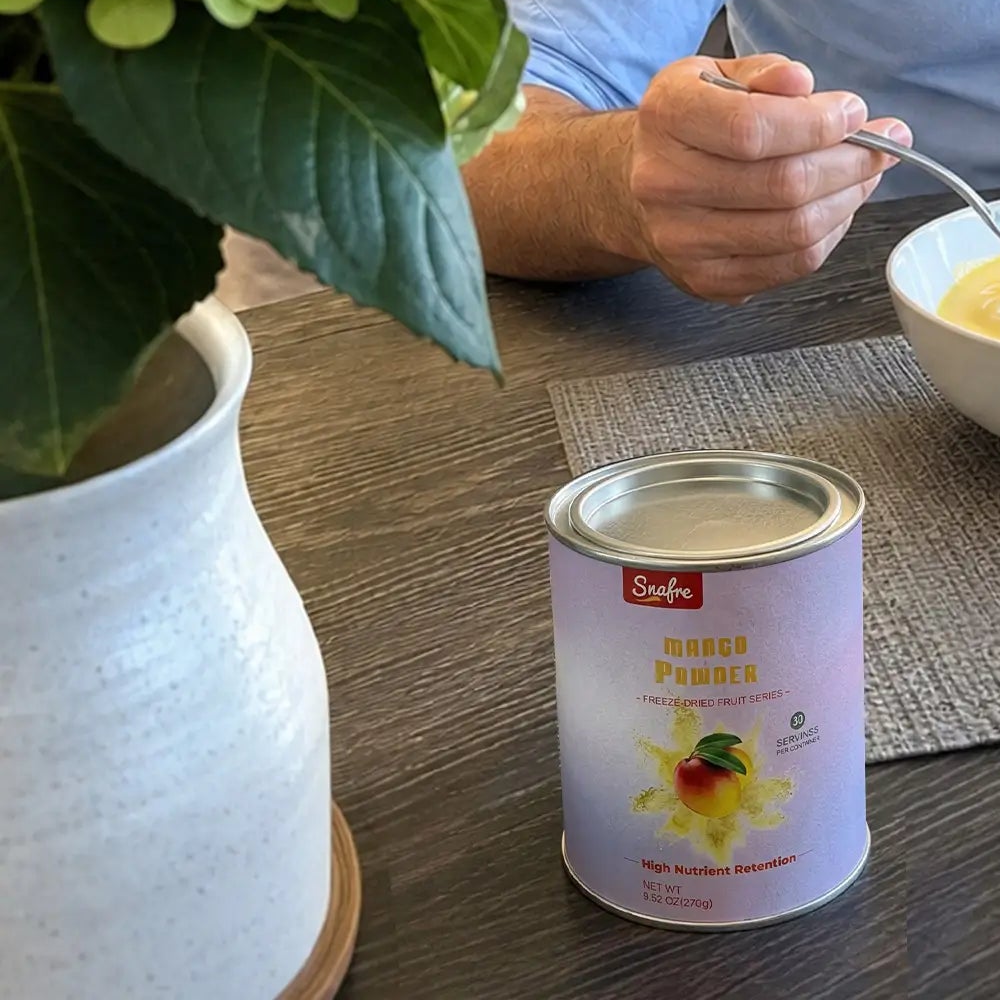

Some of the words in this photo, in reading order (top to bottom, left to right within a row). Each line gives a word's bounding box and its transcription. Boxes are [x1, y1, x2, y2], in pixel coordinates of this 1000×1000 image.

[632, 574, 694, 604] Snafre
[643, 694, 715, 708] FREEZE-DRIED
[718, 696, 746, 706] FRUIT
[749, 689, 783, 704] SERIES
[792, 714, 804, 727] 30
[776, 747, 789, 756] PER
[641, 859, 671, 874] High
[674, 864, 731, 876] Nutrient
[734, 854, 797, 875] Retention
[643, 880, 662, 892] NET
[664, 884, 682, 895] WT
[643, 892, 663, 904] 9.52
